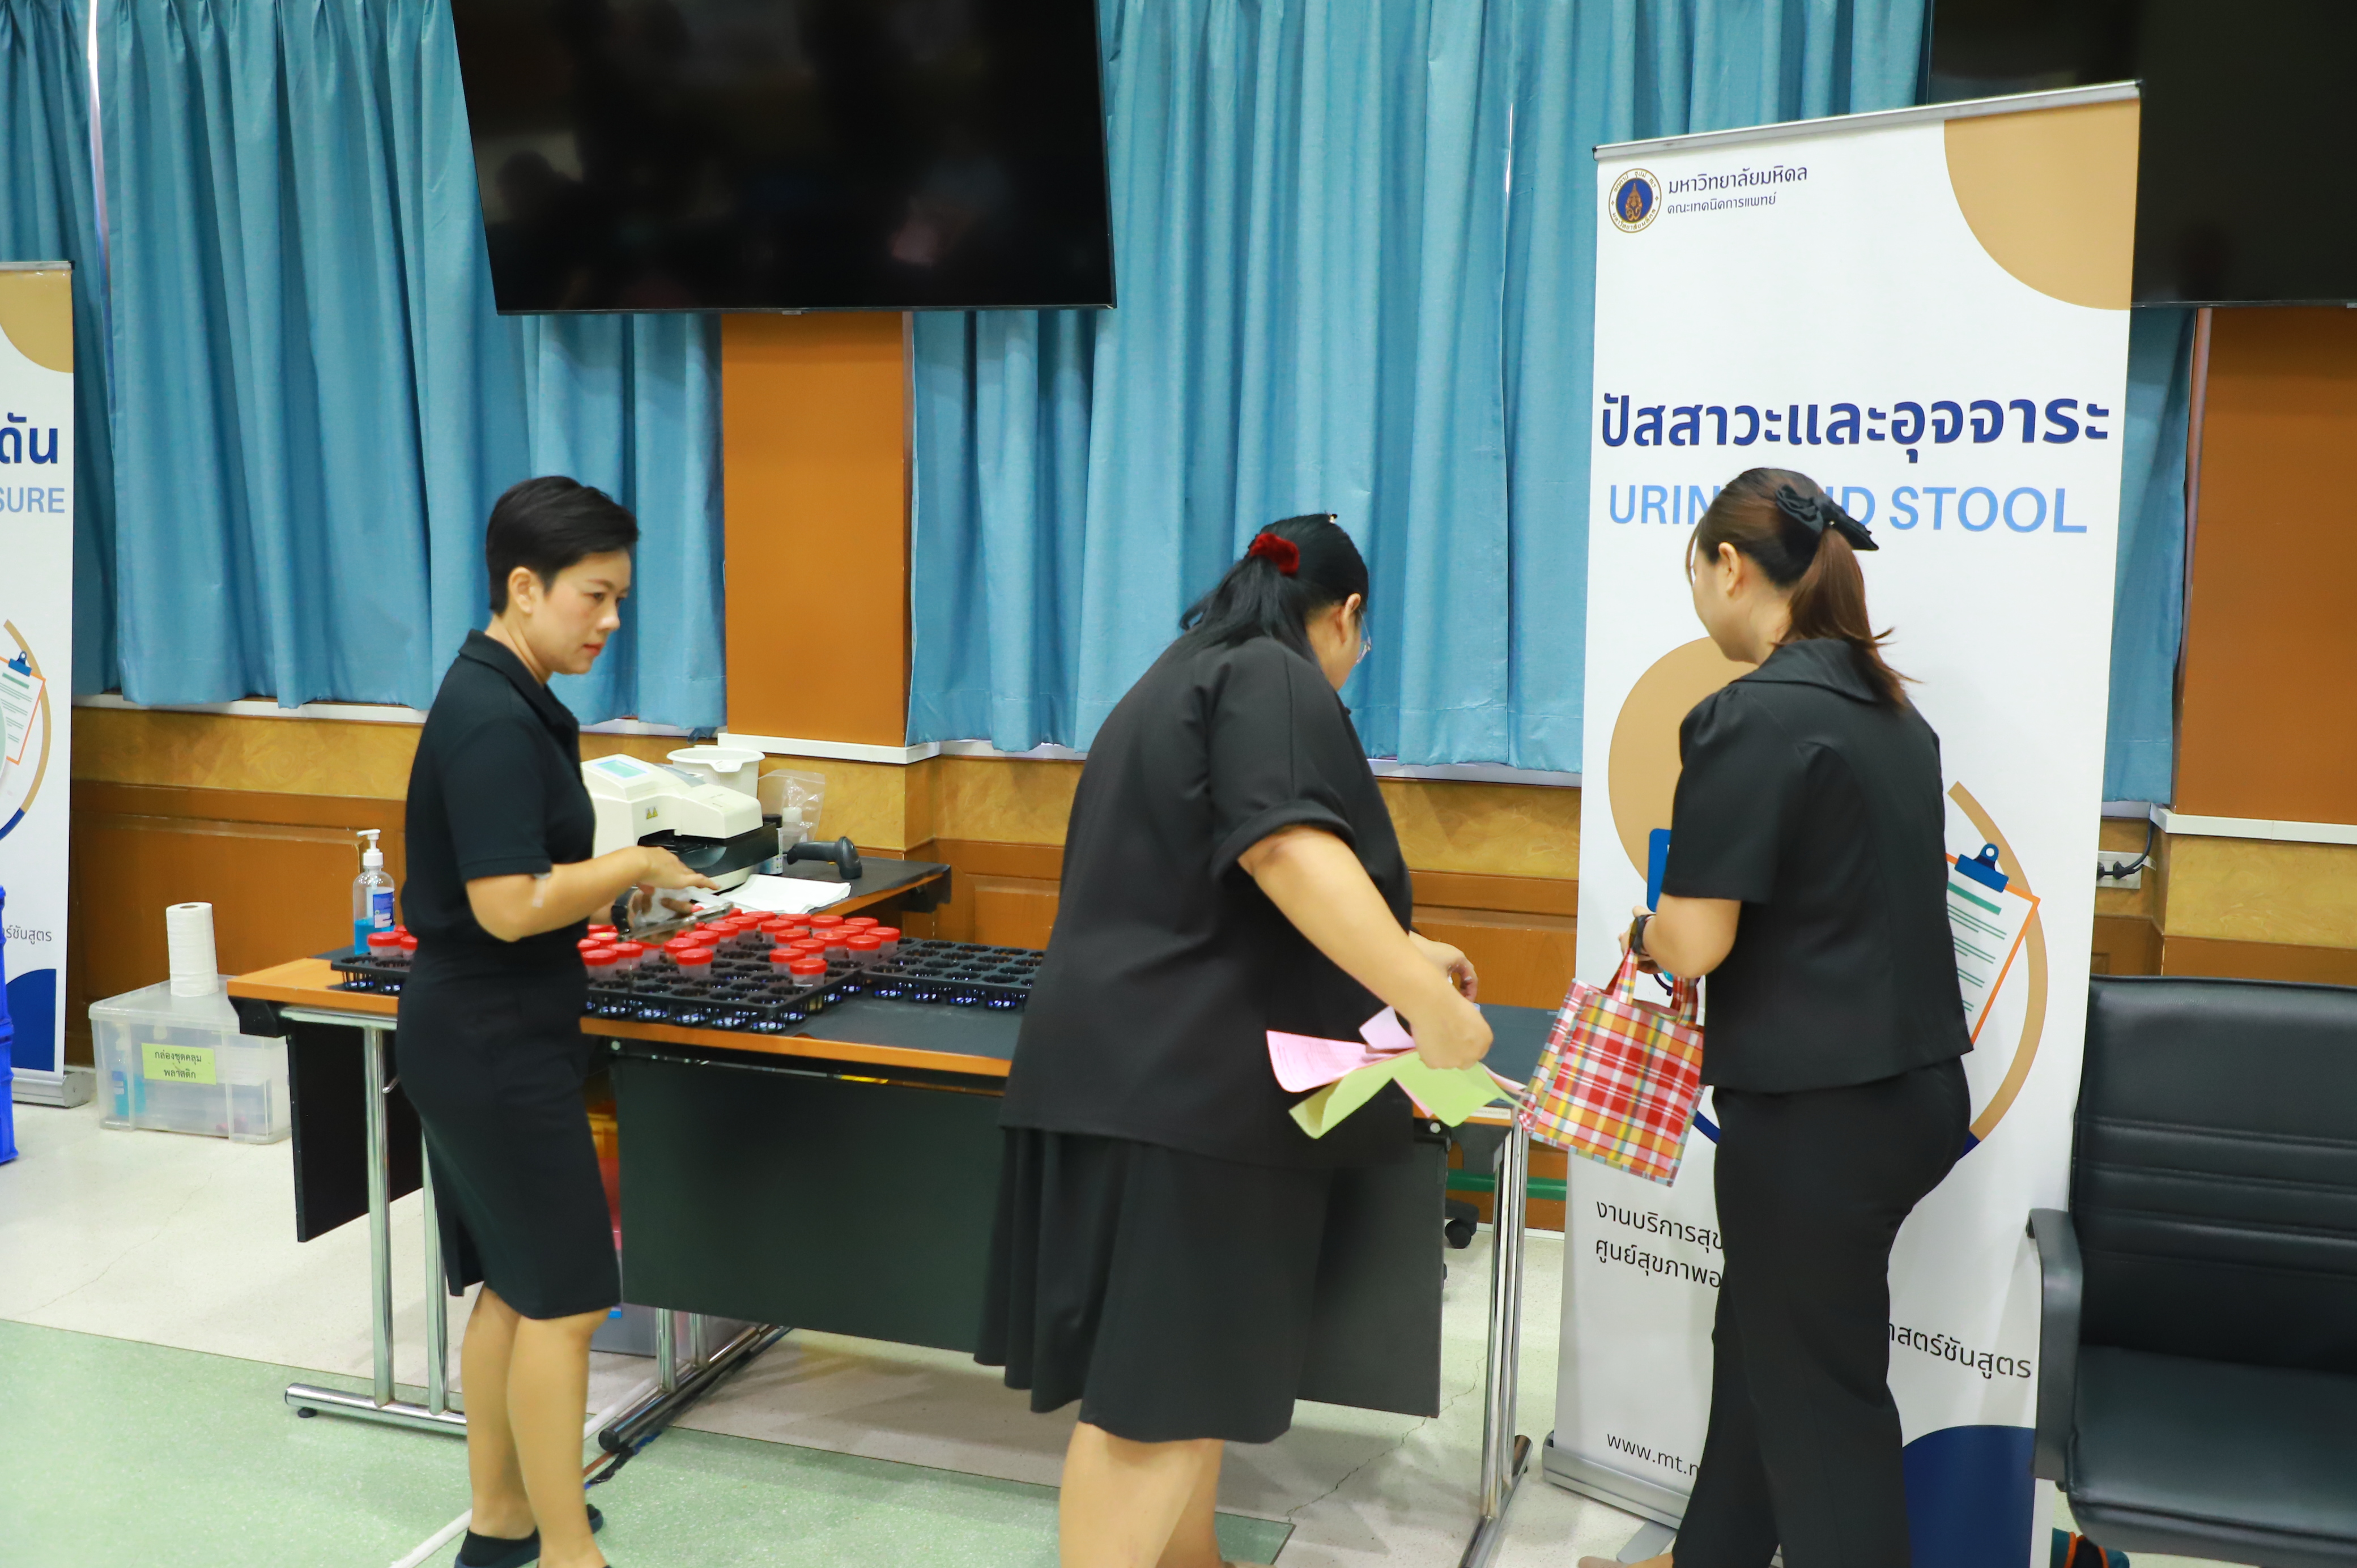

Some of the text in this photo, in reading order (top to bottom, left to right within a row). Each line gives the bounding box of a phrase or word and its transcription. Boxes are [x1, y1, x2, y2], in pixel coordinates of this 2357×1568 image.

[1669, 165, 1807, 194] มหาวิทยาลัยมหิดล
[1667, 191, 1777, 214] คณะเทคนิคการแพทย์
[1602, 393, 2109, 464] ปัสสาวะและอุจจาระ
[1610, 485, 1721, 525] URIN
[1888, 486, 2087, 534] STOOL
[2, 924, 52, 945] ร์ชันสูตร
[155, 1049, 202, 1066] กล่องชุดคลุม
[164, 1068, 196, 1079] พลาสติก
